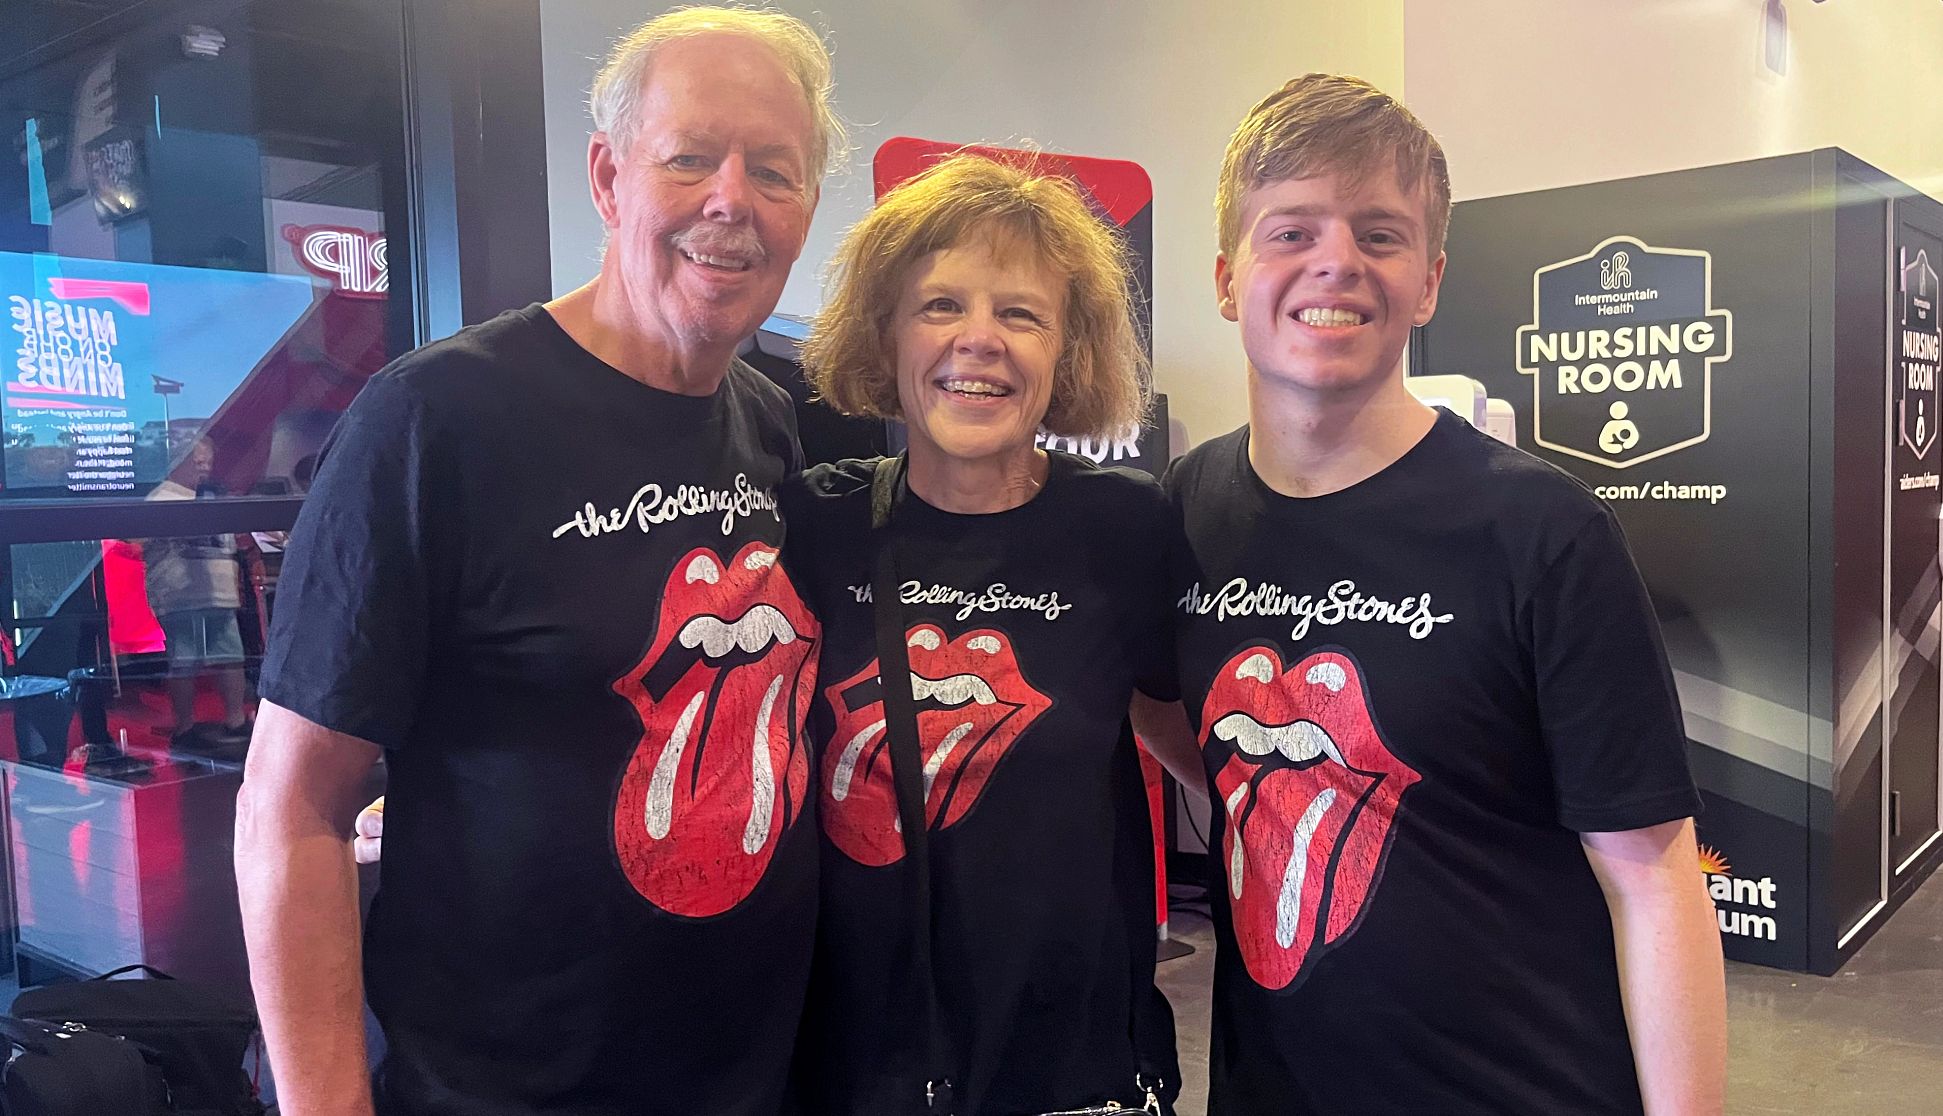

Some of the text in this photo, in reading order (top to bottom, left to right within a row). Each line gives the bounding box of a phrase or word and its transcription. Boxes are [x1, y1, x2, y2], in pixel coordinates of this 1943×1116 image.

[1574, 288, 1658, 306] Intermountain
[1597, 303, 1634, 316] Health
[1530, 321, 1715, 363] NURSING
[1903, 330, 1939, 362] NURSING
[1558, 358, 1683, 394] ROOM
[1908, 362, 1933, 390] ROOM
[552, 502, 624, 538] the
[624, 484, 735, 536] Rolling
[848, 583, 873, 603] th
[976, 583, 1072, 621] Stones
[1177, 577, 1454, 640] the Rolling Stones
[1713, 902, 1776, 941] um
